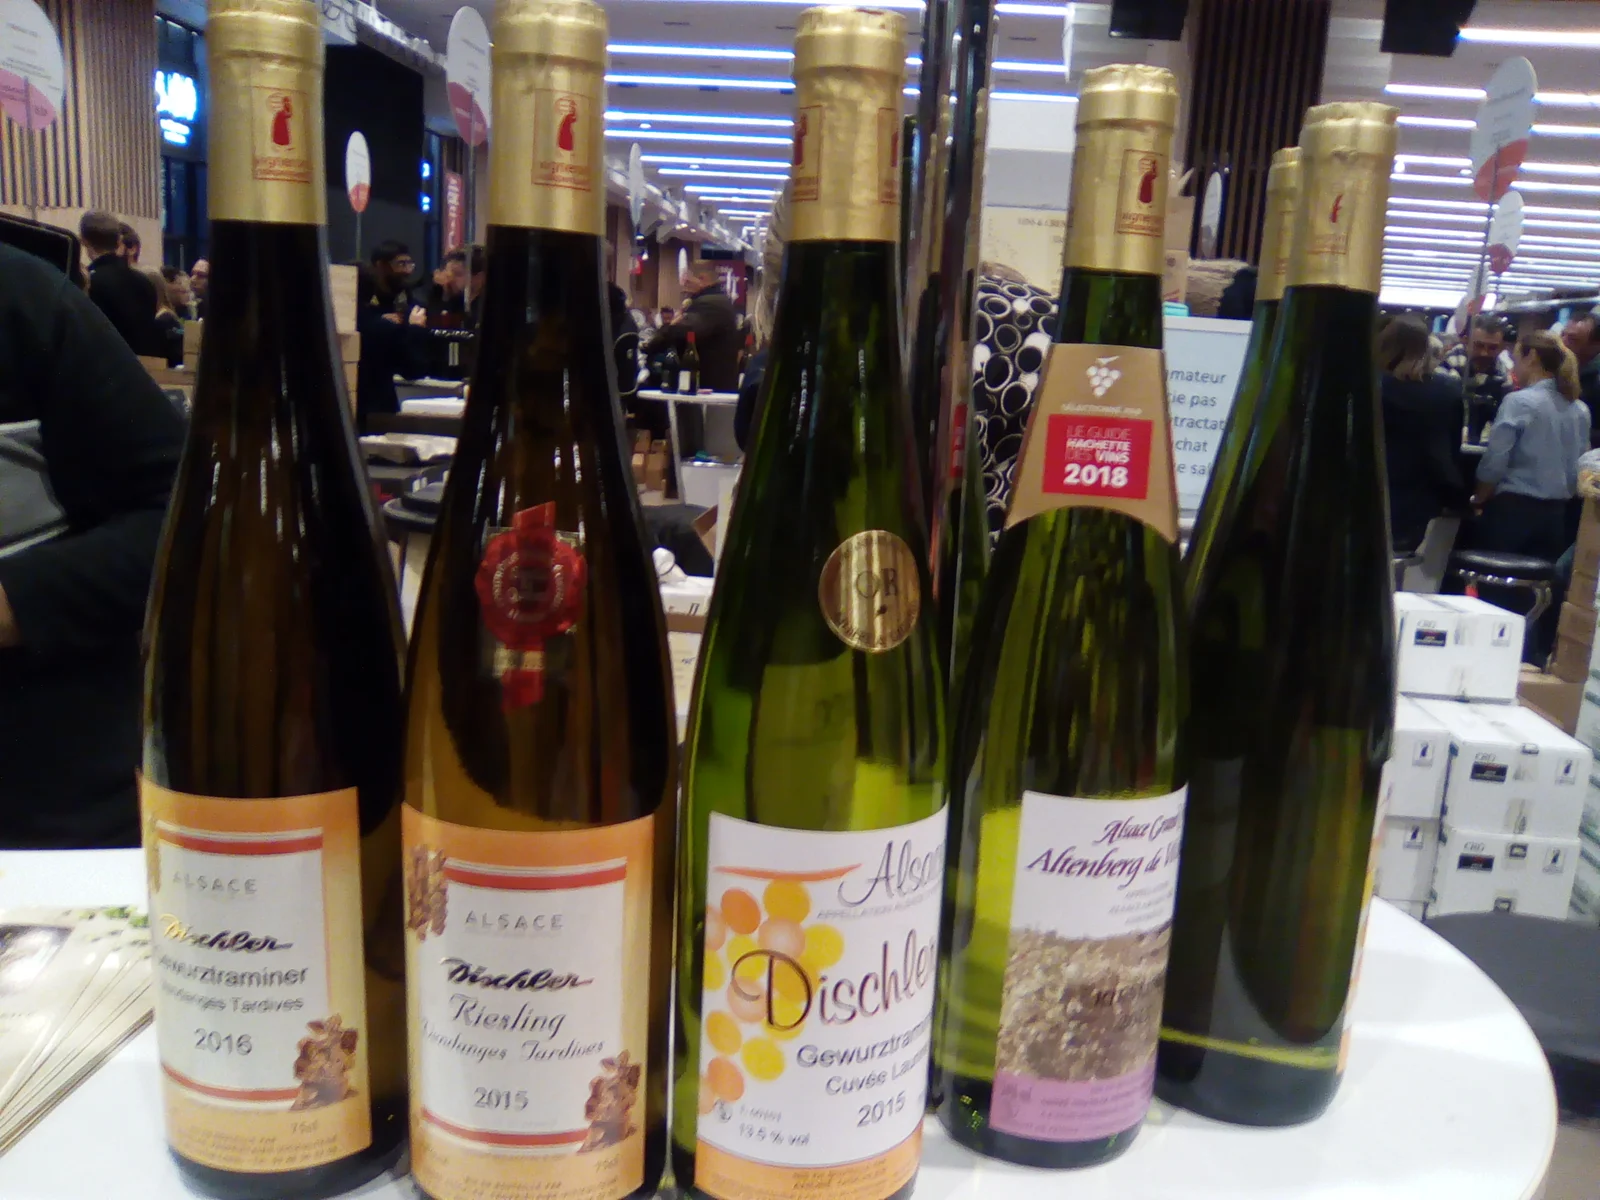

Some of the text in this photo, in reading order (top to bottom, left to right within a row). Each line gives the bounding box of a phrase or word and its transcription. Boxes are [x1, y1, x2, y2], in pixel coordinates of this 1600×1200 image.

[1189, 395, 1217, 409] pas
[1066, 425, 1131, 440] LE GUIDE
[1066, 438, 1131, 452] HACHETTE
[1065, 448, 1130, 464] DES VINS
[1063, 462, 1128, 488] 2018
[856, 567, 898, 599] OR
[1092, 816, 1150, 846] Alsace
[1024, 845, 1145, 891] Altenberg
[1144, 847, 1162, 873] de
[172, 873, 258, 895] ALSACE
[465, 909, 564, 931] ALSACE
[439, 957, 595, 992] Dischler
[450, 993, 567, 1041] Riesling
[193, 1027, 253, 1056] 2016
[520, 1038, 605, 1062] Tardives
[825, 1070, 888, 1096] Cuvée
[473, 1086, 529, 1111] 2015
[857, 1090, 905, 1128] 2015
